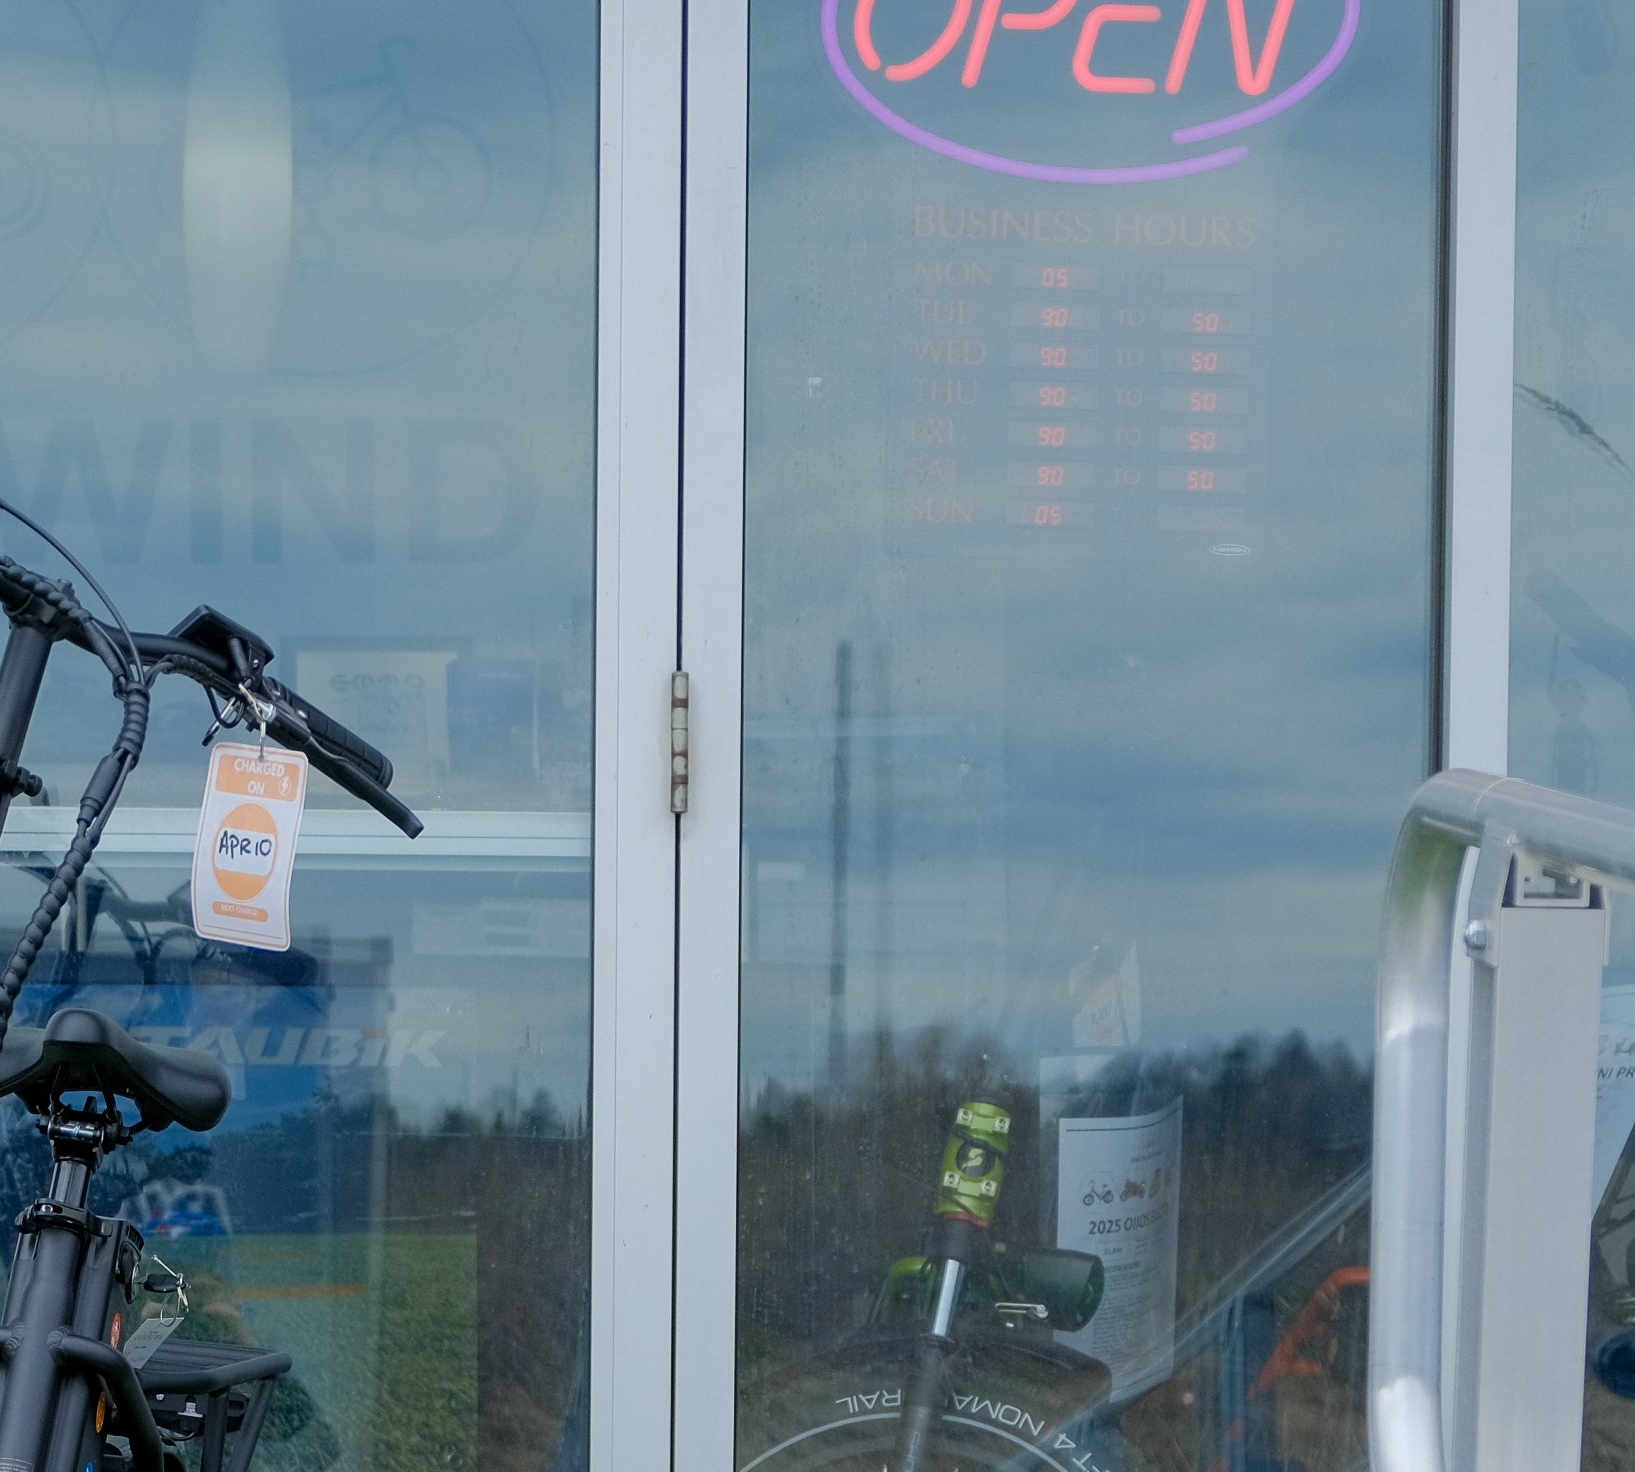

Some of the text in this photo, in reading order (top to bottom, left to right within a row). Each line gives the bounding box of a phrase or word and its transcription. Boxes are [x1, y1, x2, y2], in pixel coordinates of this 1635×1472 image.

[915, 206, 1256, 249] BUSINESS HOURS
[916, 260, 995, 286] MON
[918, 299, 972, 326] TUE
[1117, 309, 1146, 327] TO
[915, 338, 987, 366] WED
[1116, 348, 1145, 367] TO
[912, 378, 980, 405] THU
[1115, 388, 1144, 407] TO
[910, 418, 955, 444] FRI
[1114, 428, 1142, 447] TO
[909, 457, 960, 484] SAT
[1113, 467, 1142, 487] TO
[908, 496, 974, 523] SUN
[234, 757, 285, 776] CHARGED
[247, 780, 266, 795] ON
[218, 830, 273, 859] APR 10
[1088, 1219, 1122, 1235] 2025
[945, 1391, 1045, 1437] NOMA
